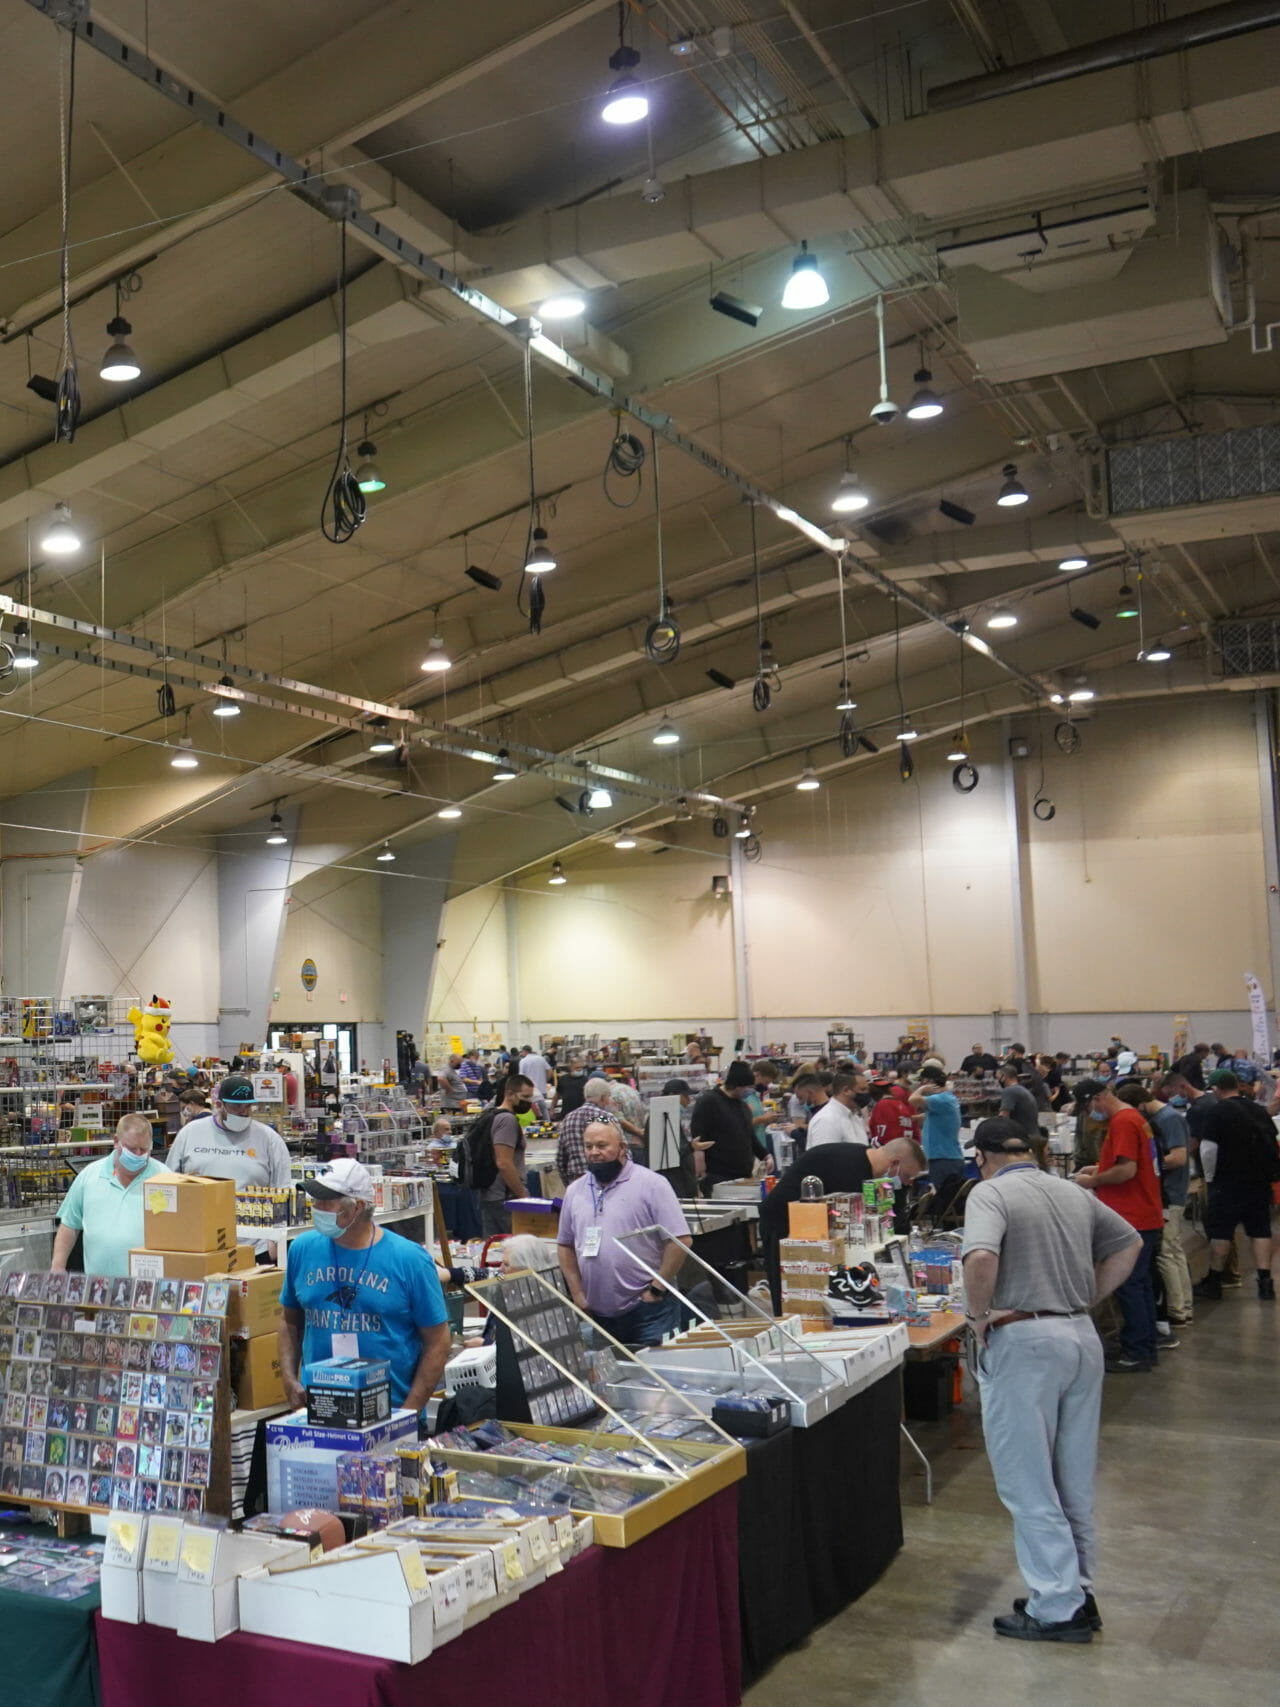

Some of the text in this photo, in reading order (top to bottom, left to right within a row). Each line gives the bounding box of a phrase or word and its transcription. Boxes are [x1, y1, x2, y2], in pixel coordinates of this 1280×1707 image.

[193, 1146, 246, 1156] carhartt
[307, 1266, 389, 1293] CAROLINA
[305, 1308, 381, 1332] PANTHERS
[302, 1429, 313, 1437] Full
[347, 1432, 360, 1440] Case
